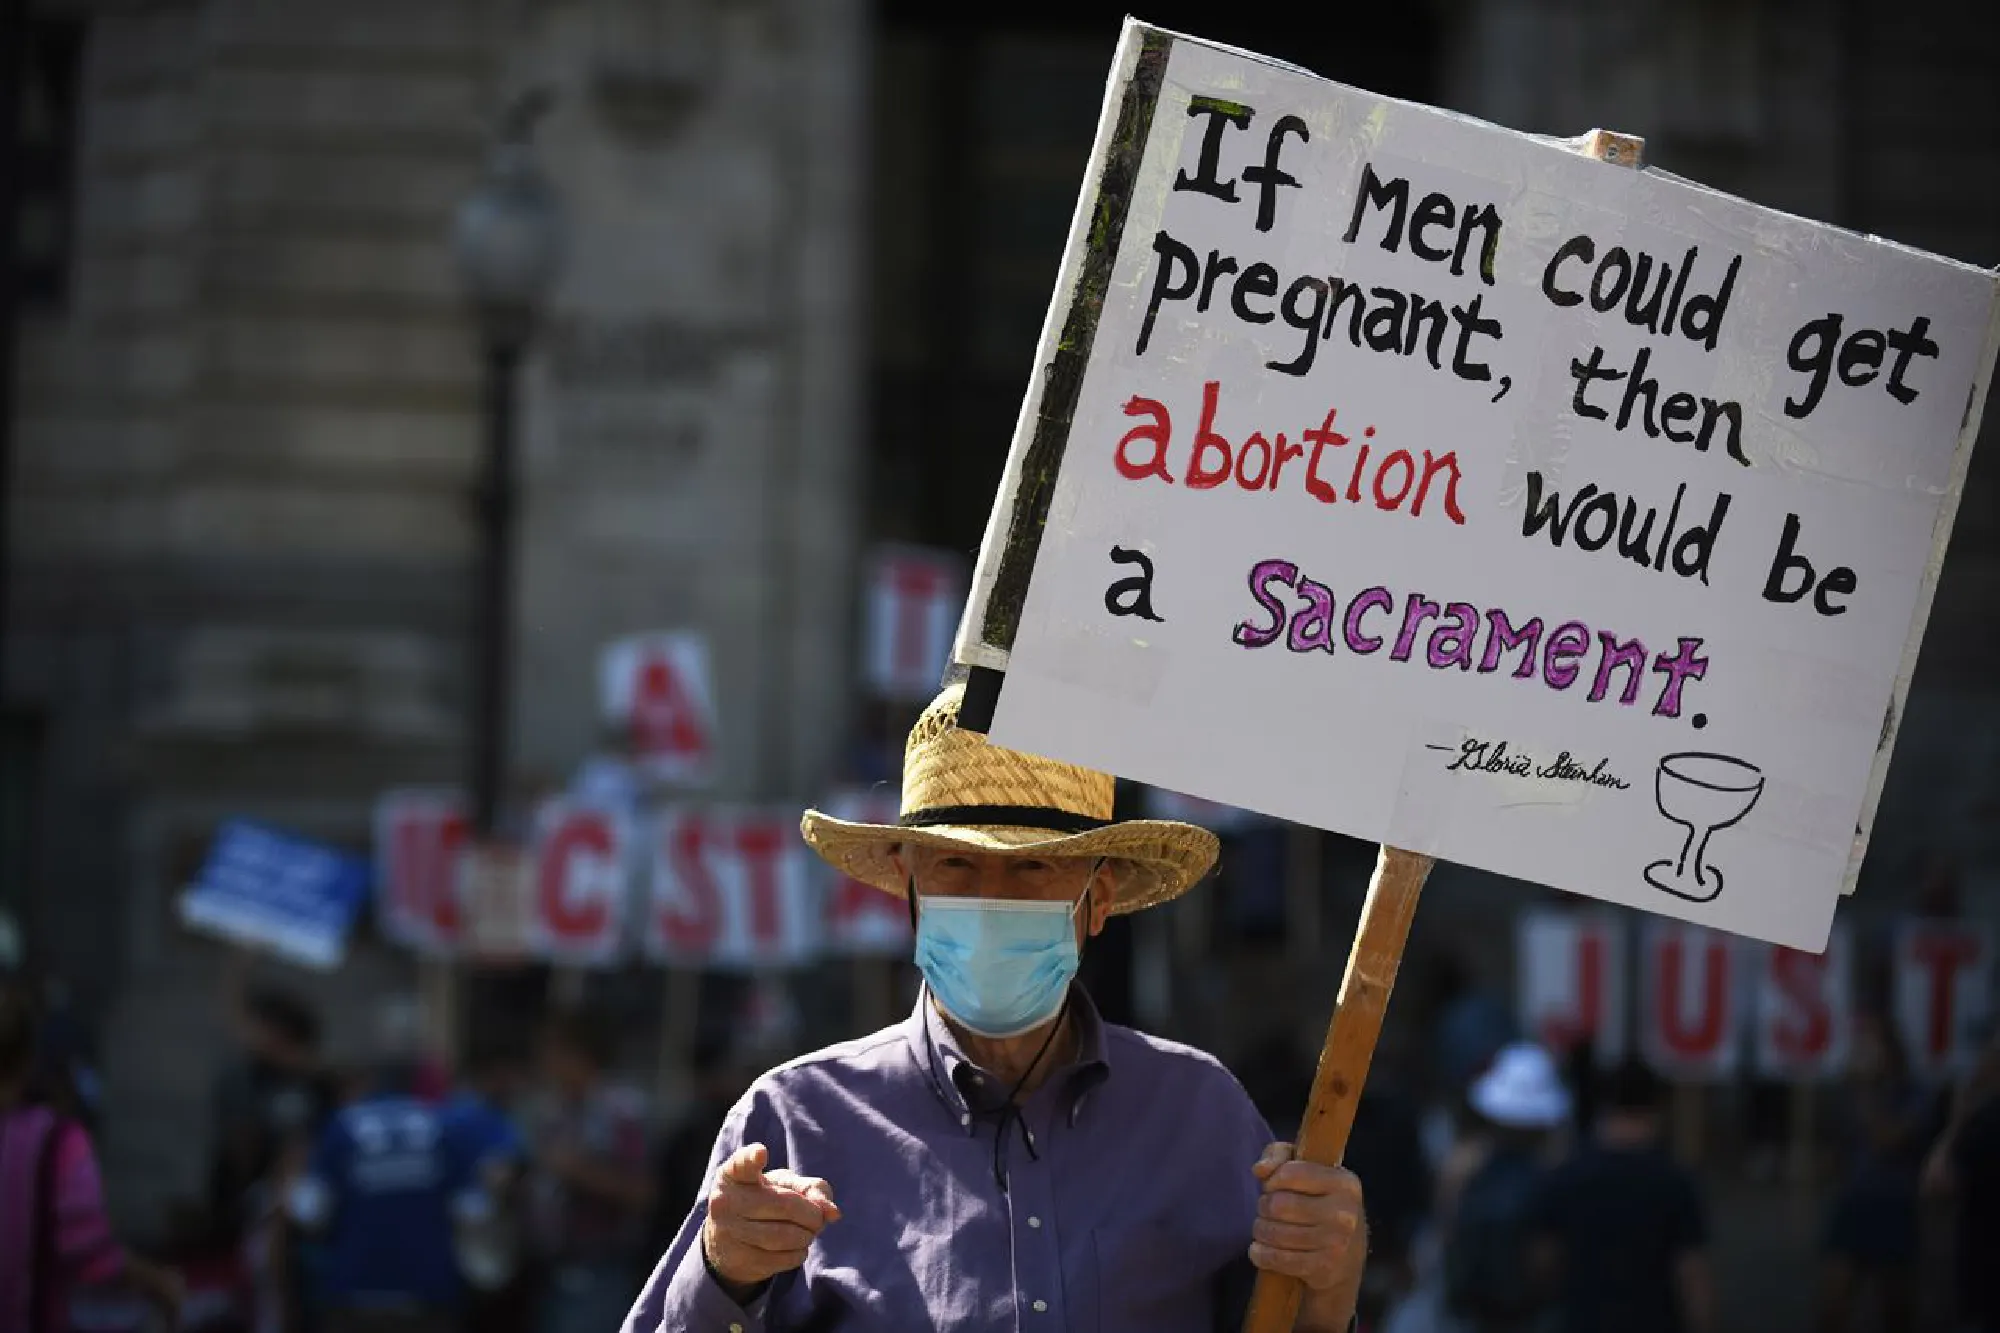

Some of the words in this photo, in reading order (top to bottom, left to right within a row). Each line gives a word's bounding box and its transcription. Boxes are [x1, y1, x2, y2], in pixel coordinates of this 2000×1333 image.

[1135, 229, 1512, 404] pregnant,
[1569, 344, 1751, 468] then
[1173, 94, 1310, 233] If
[1541, 235, 1743, 353] could
[1783, 312, 1940, 420] get
[1104, 544, 1165, 623] a
[1114, 380, 1465, 526] abortion
[1522, 469, 1732, 587] would
[1761, 512, 1858, 617] be
